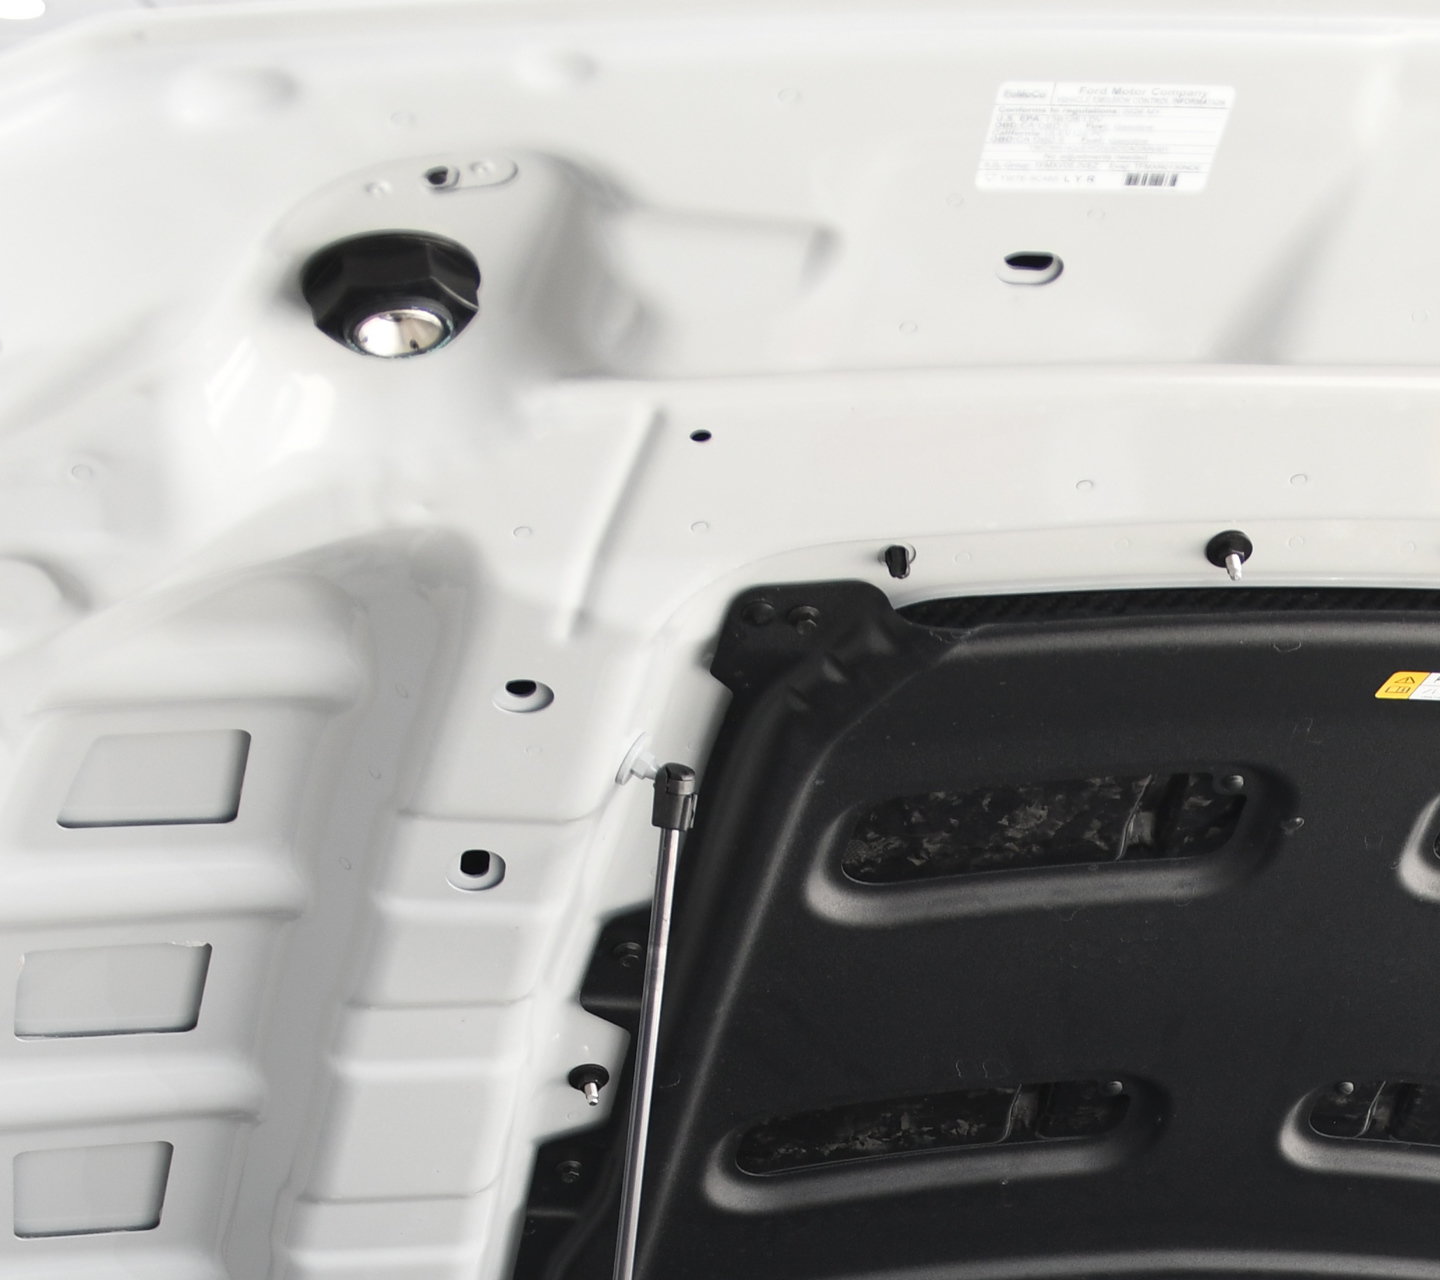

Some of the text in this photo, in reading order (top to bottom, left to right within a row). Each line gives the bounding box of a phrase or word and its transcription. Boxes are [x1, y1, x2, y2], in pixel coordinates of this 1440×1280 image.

[1079, 86, 1209, 99] Ford Motor Company
